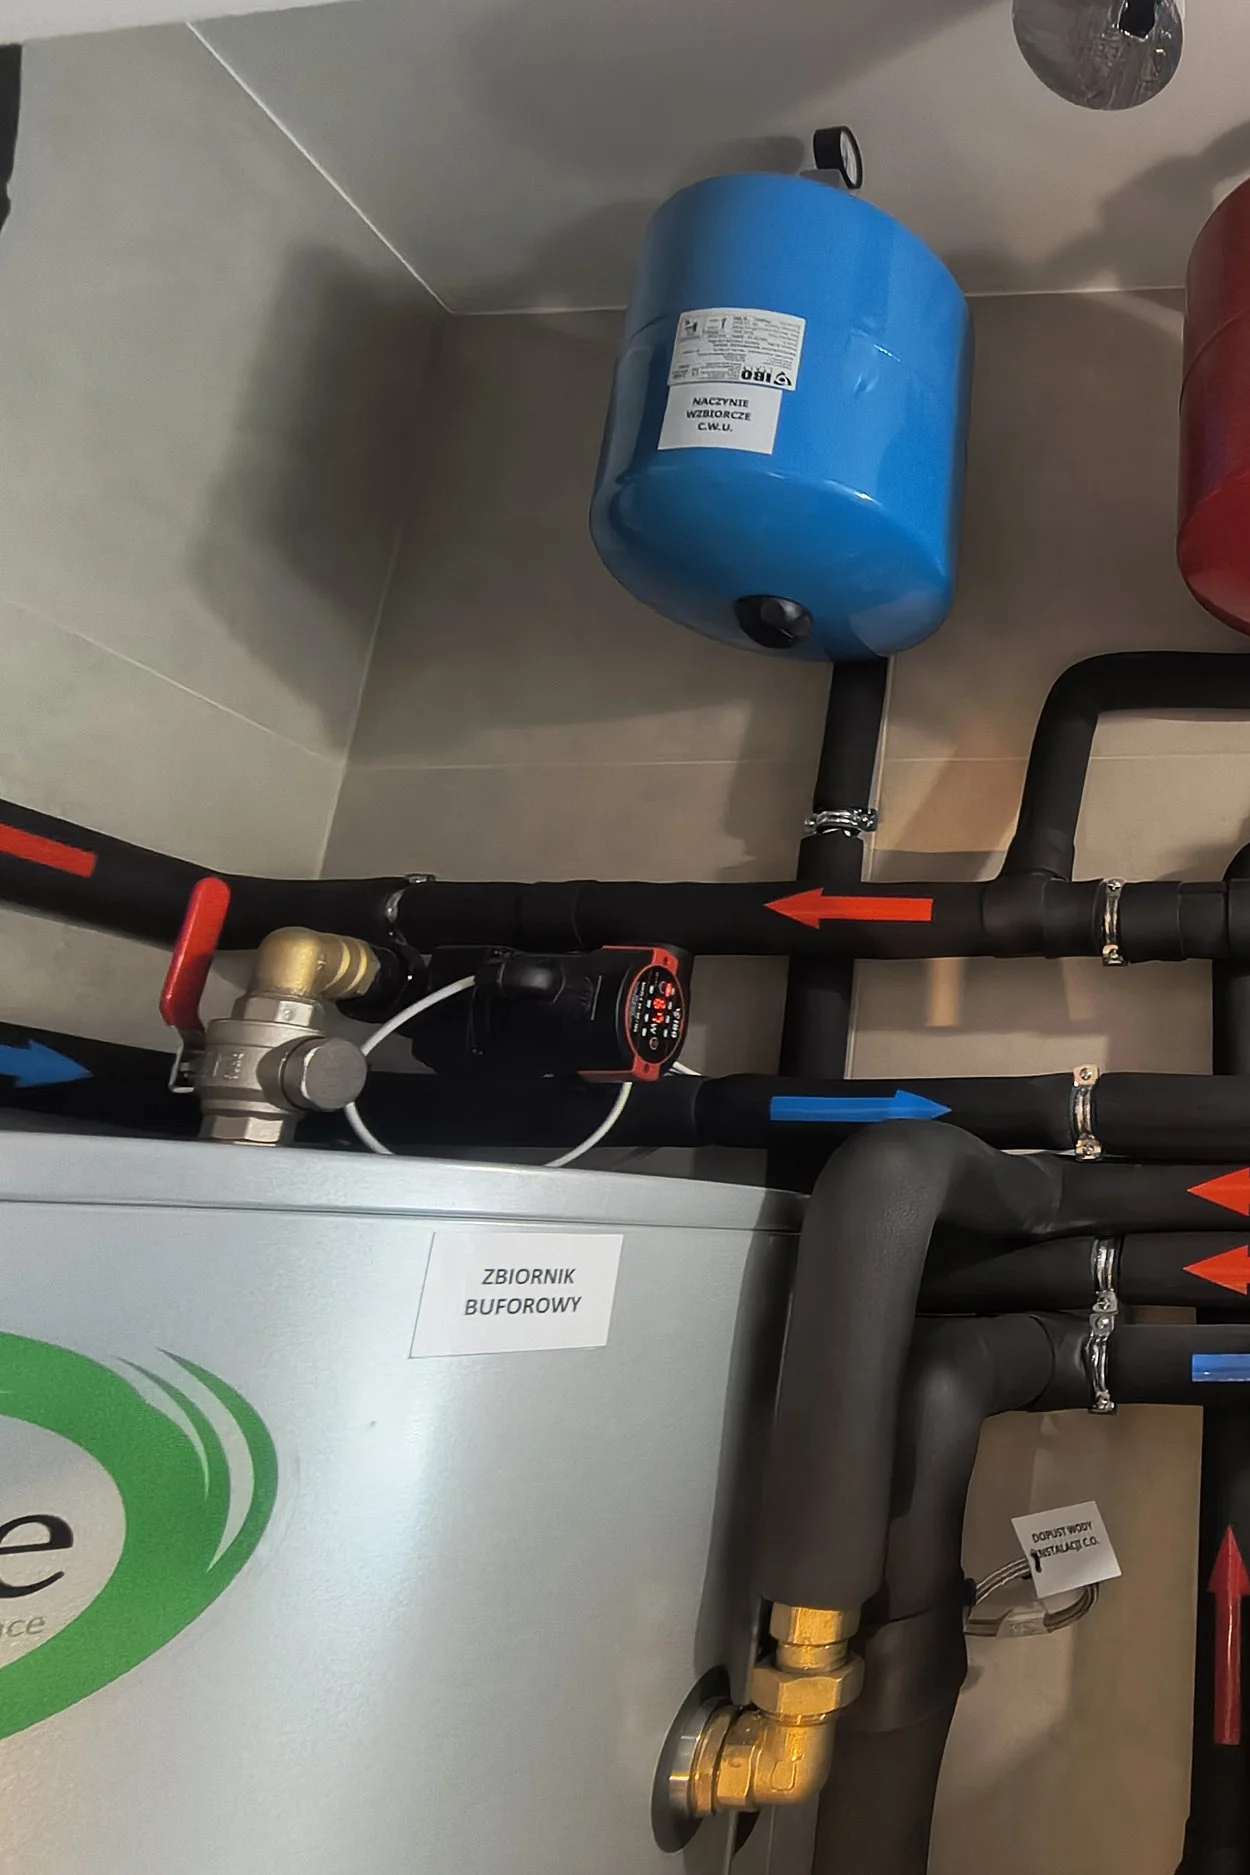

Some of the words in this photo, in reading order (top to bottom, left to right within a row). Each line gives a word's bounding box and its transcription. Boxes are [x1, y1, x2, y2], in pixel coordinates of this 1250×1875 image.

[741, 369, 771, 383] IBO
[692, 397, 749, 408] NACZYNIE
[686, 409, 751, 421] WZBIORCZE
[697, 422, 733, 432] C.W.U.
[482, 1268, 576, 1285] ZBIORNIK
[464, 1296, 582, 1316] BUFOROWY
[1032, 1526, 1067, 1543] DOPUST
[1066, 1521, 1093, 1535] WODY
[1034, 1539, 1082, 1558] NSTALACJI
[0, 1616, 46, 1638] ce
